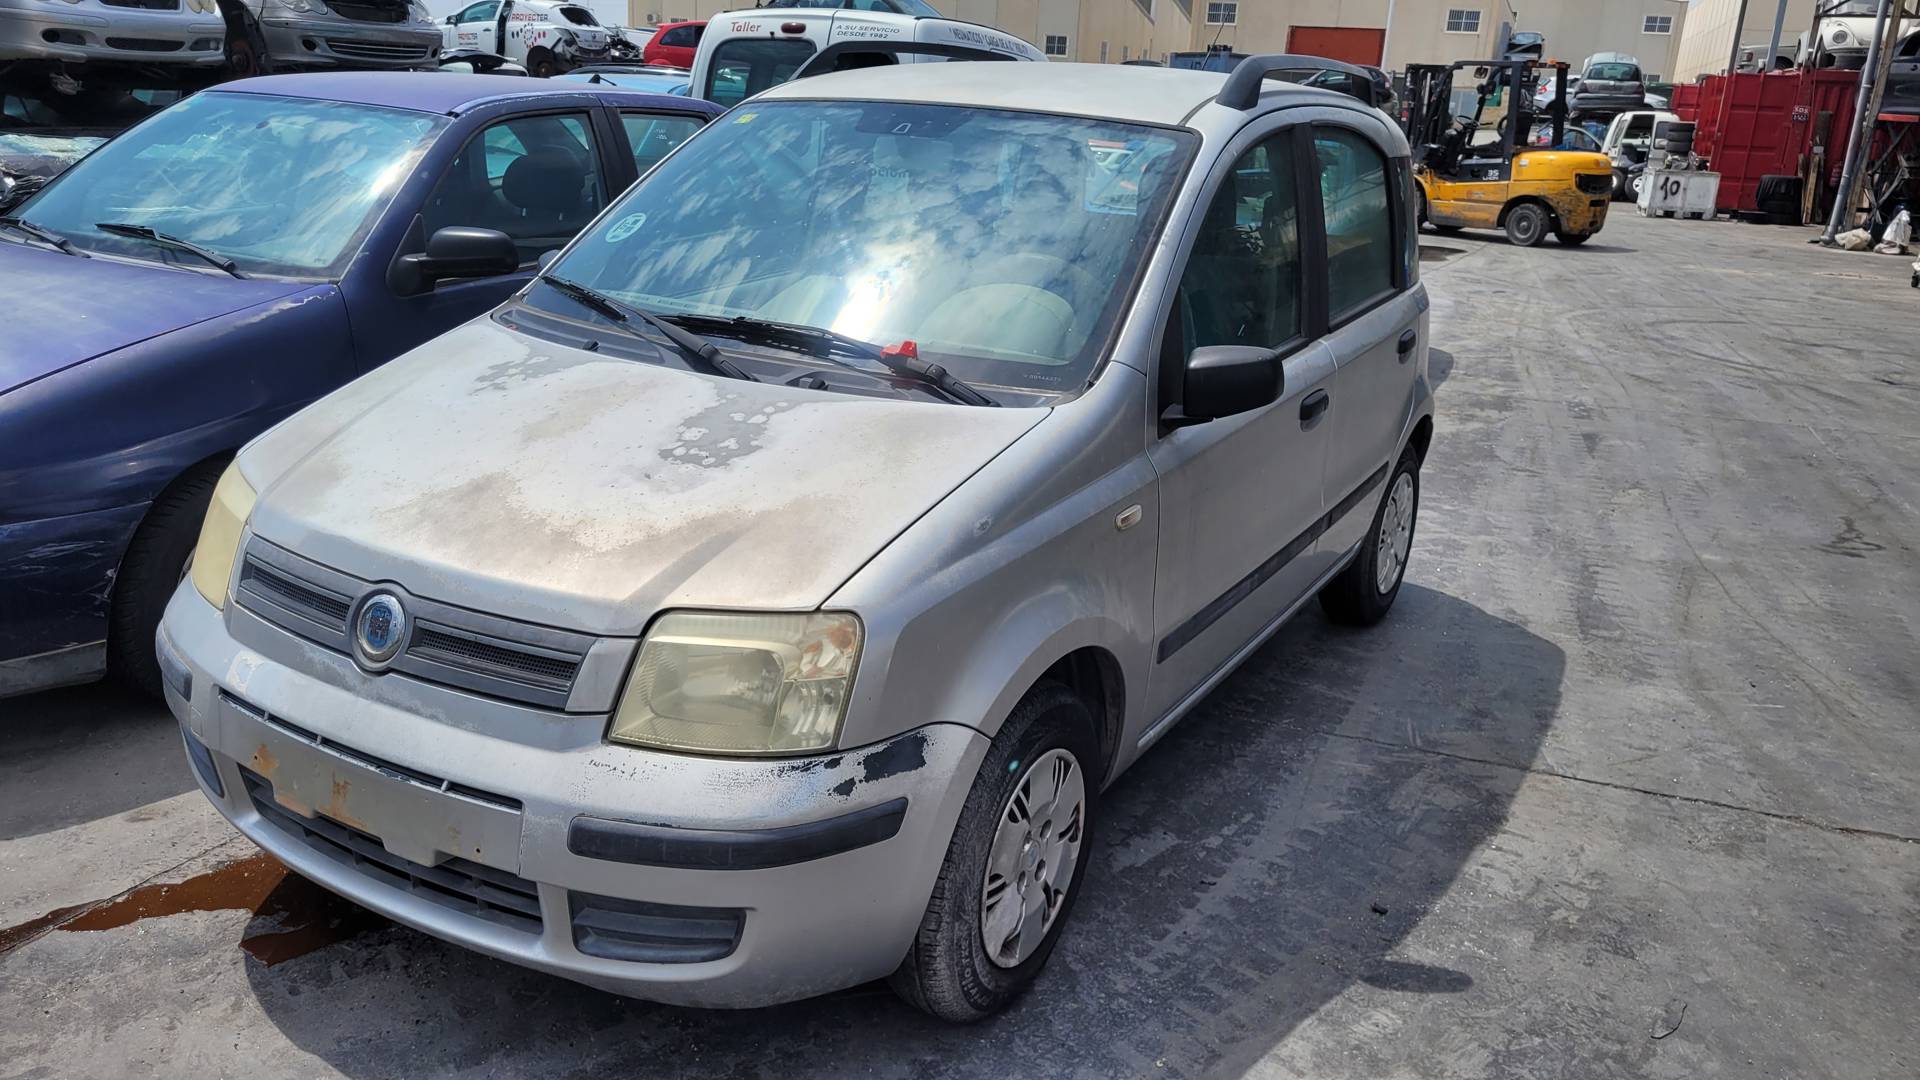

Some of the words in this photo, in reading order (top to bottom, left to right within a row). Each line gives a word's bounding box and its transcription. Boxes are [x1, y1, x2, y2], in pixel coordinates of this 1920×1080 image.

[731, 22, 761, 32] Taller
[857, 26, 900, 34] SERVICIO
[1660, 176, 1680, 200] 10
